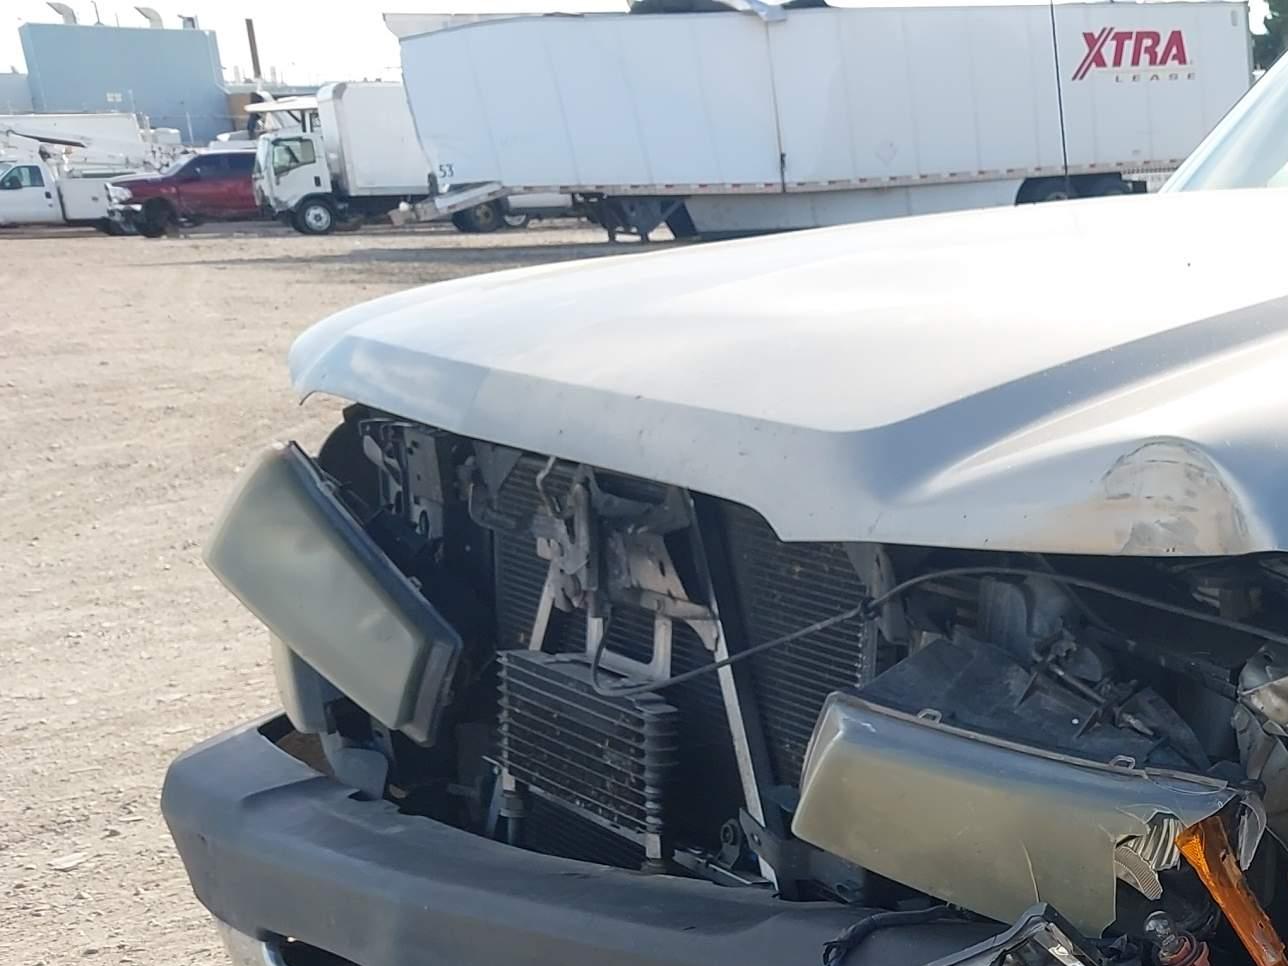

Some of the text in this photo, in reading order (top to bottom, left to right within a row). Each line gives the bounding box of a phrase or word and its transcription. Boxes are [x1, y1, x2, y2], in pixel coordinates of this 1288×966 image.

[1072, 27, 1187, 81] XTRA
[1115, 73, 1195, 83] LEASE
[439, 164, 454, 178] 53
